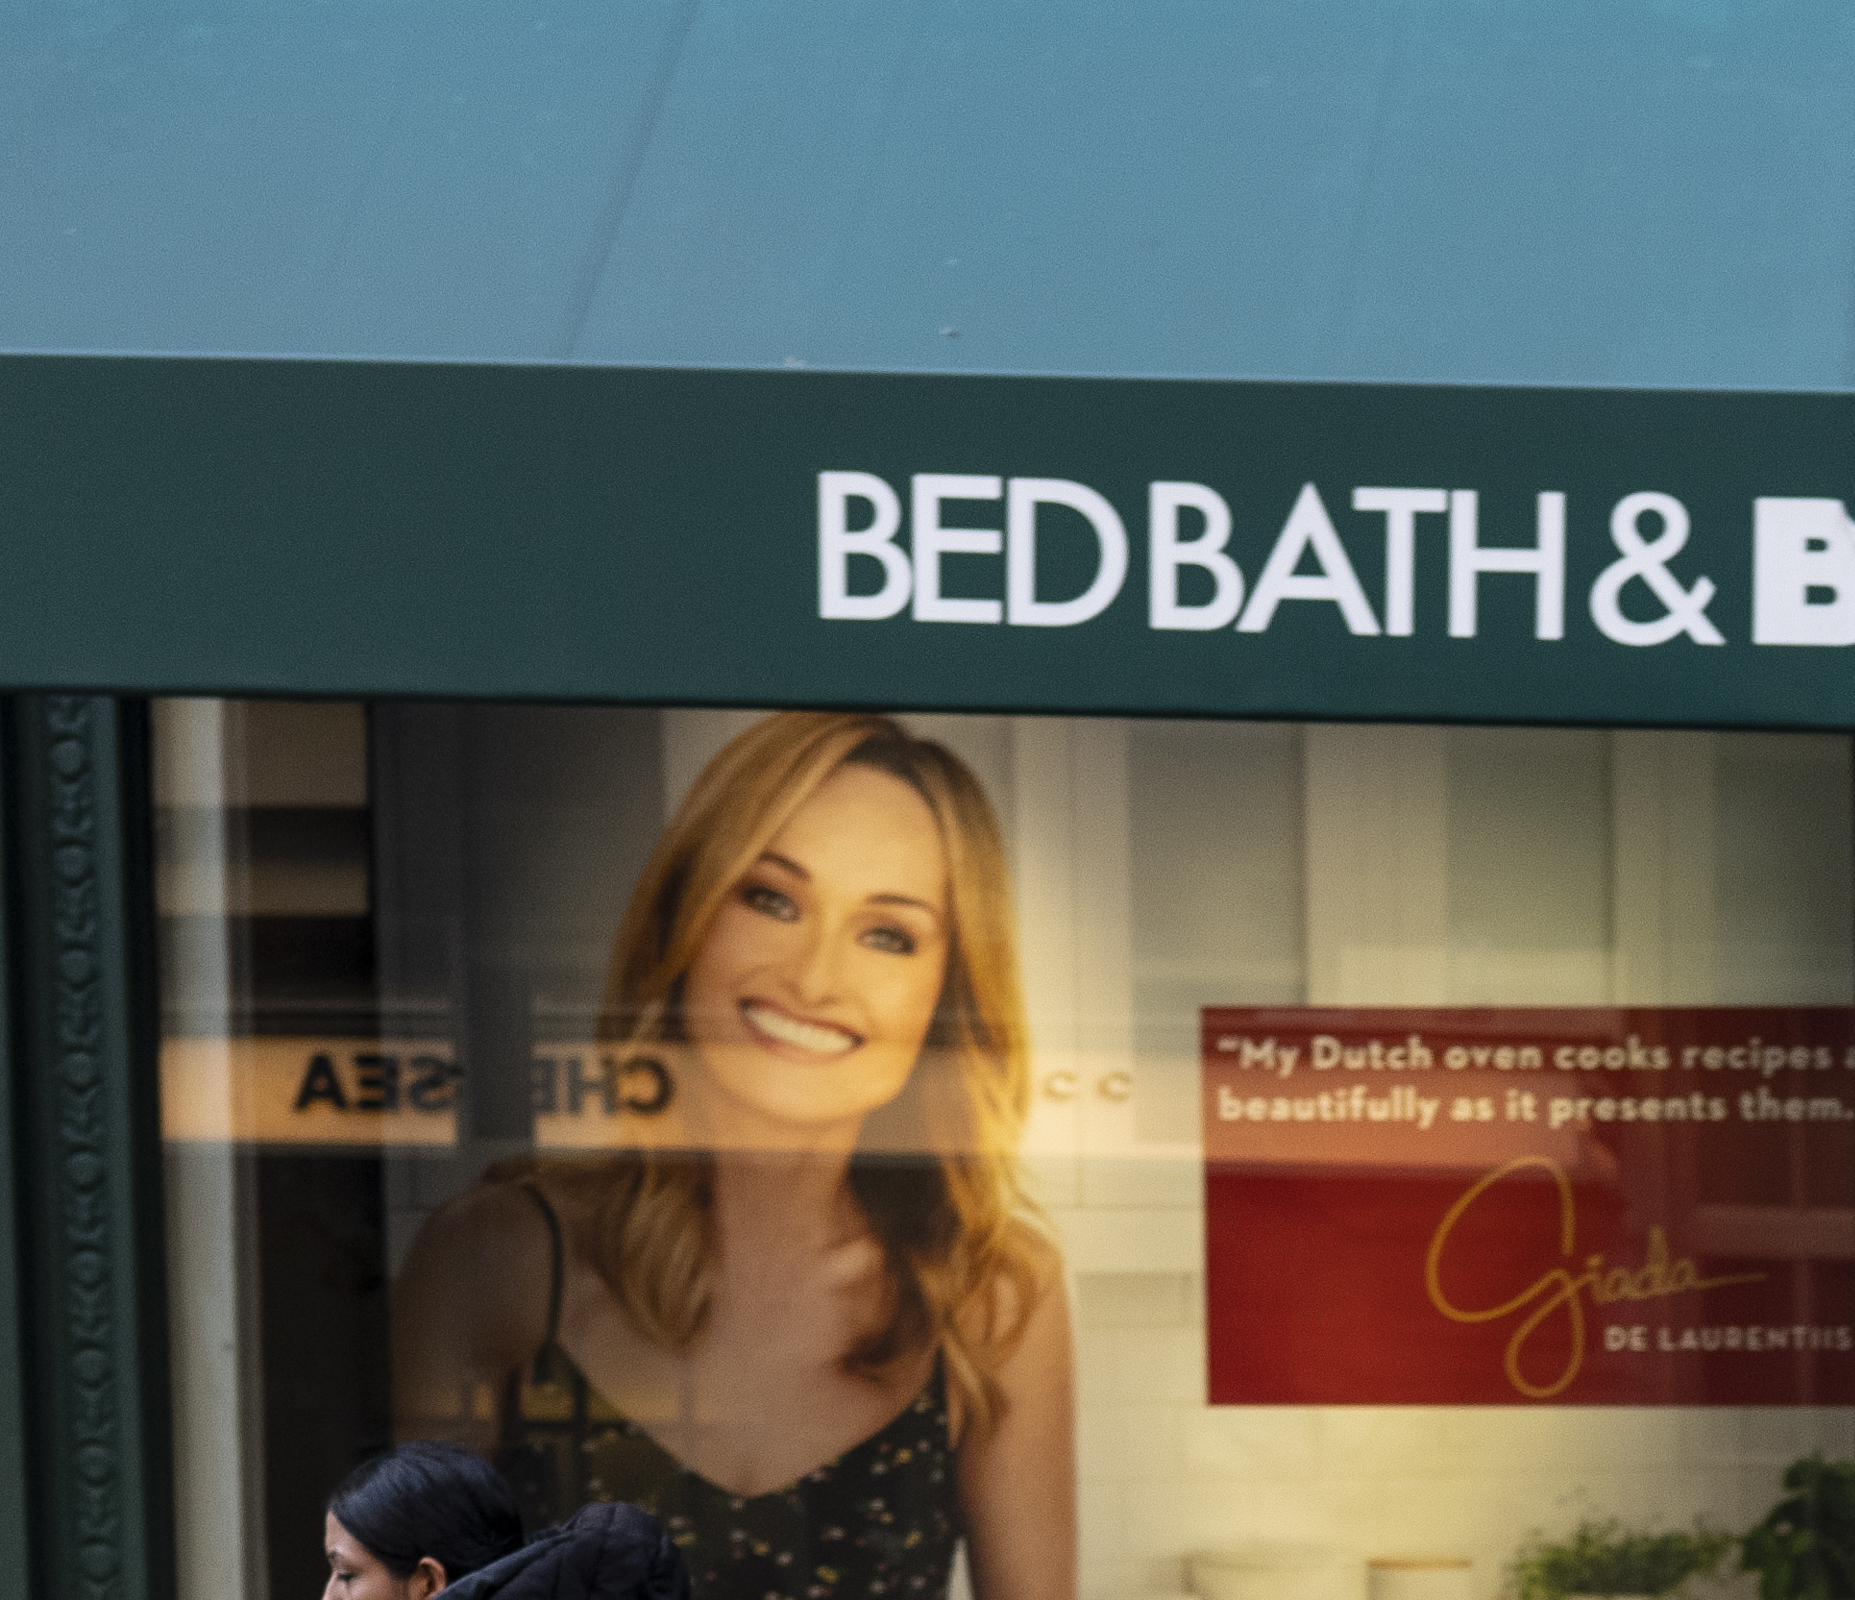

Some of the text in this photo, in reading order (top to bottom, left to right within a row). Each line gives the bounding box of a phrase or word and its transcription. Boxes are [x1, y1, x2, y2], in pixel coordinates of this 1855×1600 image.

[817, 469, 1129, 628] BED
[1148, 480, 1567, 642] BATH
[1589, 490, 1726, 648] &
[1310, 1034, 1434, 1070] Dutch
[1443, 1046, 1544, 1070] oven
[1553, 1035, 1671, 1070] cooks
[1682, 1036, 1834, 1078] recipes
[1217, 1085, 1440, 1130] beautifully
[1451, 1097, 1496, 1122] as
[1505, 1088, 1539, 1122] it
[1546, 1092, 1729, 1131] presents
[1603, 1326, 1649, 1352] DE
